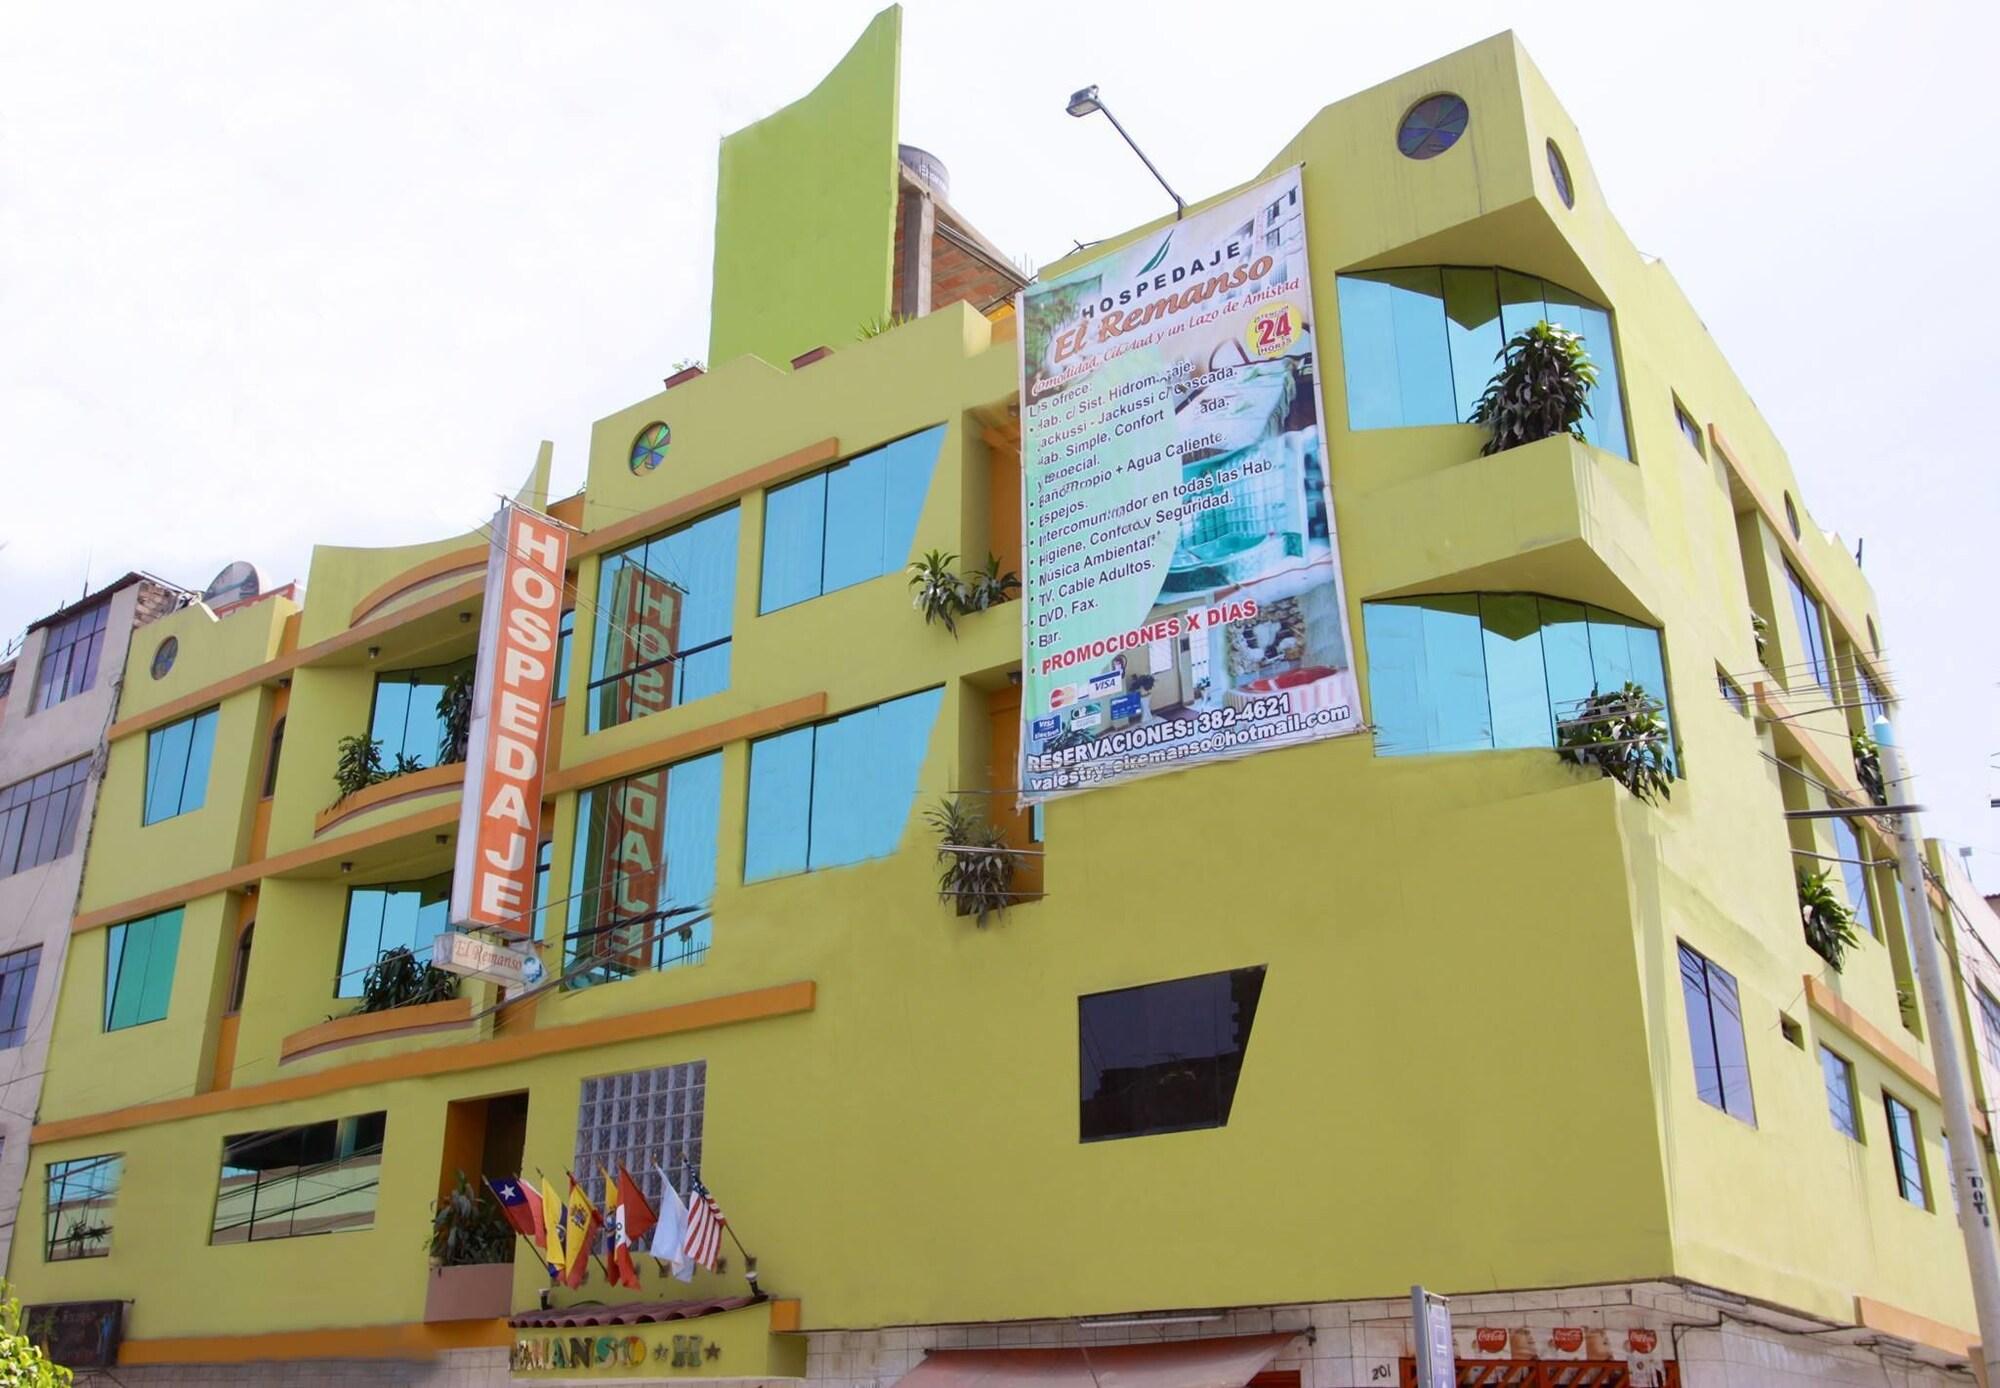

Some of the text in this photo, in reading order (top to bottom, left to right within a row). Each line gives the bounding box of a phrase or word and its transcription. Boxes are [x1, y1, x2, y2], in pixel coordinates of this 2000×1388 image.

[1082, 241, 1240, 319] HOSPEDAJE
[1054, 255, 1274, 364] El Remanso
[1168, 323, 1185, 337] un
[1189, 310, 1219, 328] Lazo
[1223, 300, 1239, 315] de
[1242, 278, 1299, 307] Amistad
[1257, 312, 1292, 346] 24
[1037, 422, 1087, 452] ackussi
[1098, 392, 1154, 424] Jackussi
[1126, 451, 1161, 472] Agua
[1152, 490, 1169, 504] en
[1173, 474, 1213, 497] todas
[1217, 468, 1238, 484] las
[1155, 491, 1234, 524] Seguridad.
[1058, 576, 1095, 598] Cable
[1098, 558, 1156, 585] Adultos.
[1041, 600, 1257, 676] PROMOCIONES X DÍAS
[1094, 678, 1116, 691] VISA
[479, 520, 559, 922] HOSPEDAJE
[1027, 692, 1290, 772] RESERVACIONES: 382-4621
[456, 941, 522, 972] El Remanso
[1372, 1363, 1392, 1381] 201
